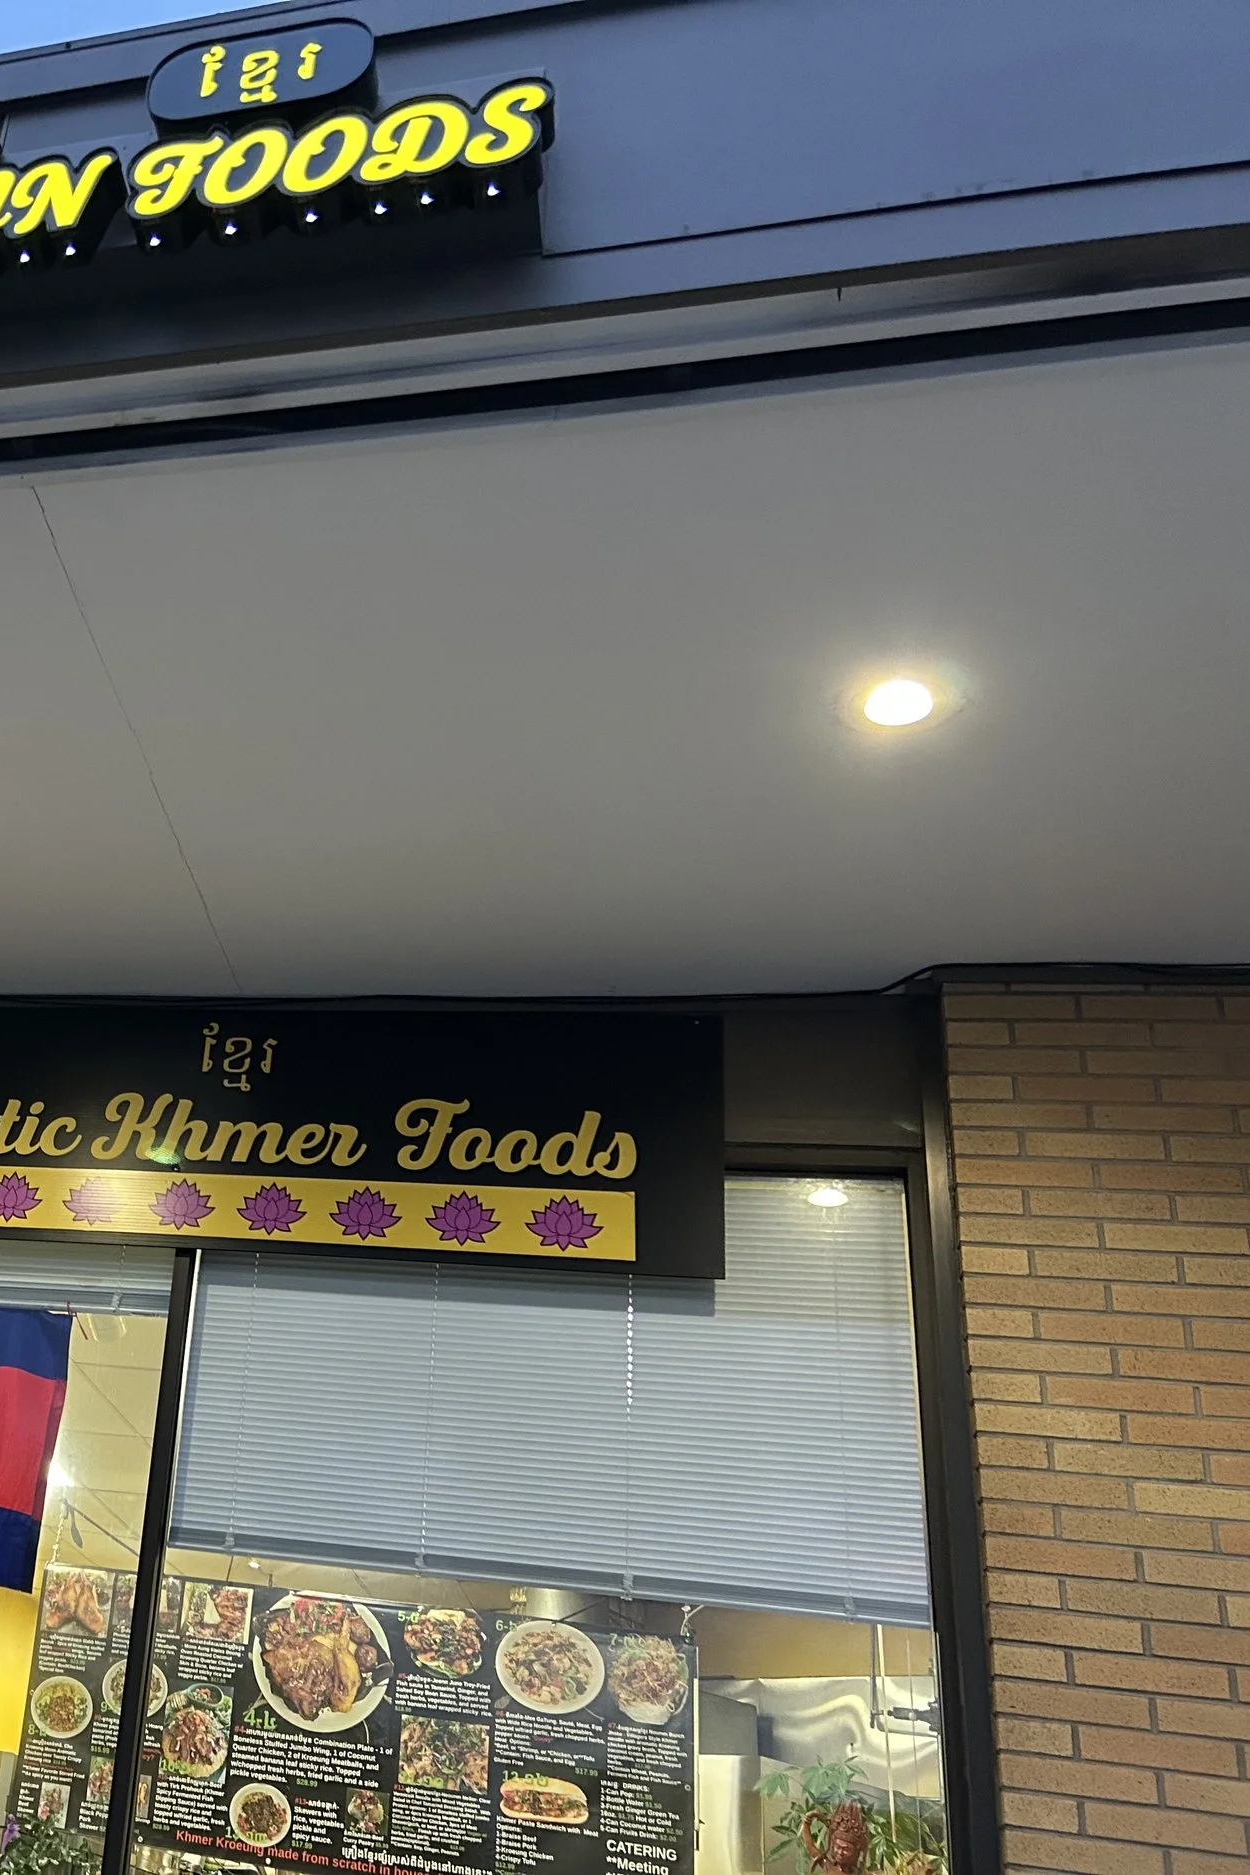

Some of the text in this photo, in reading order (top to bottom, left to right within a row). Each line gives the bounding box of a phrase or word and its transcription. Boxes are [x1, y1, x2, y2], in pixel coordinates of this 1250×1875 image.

[127, 84, 548, 218] FOODS
[91, 1092, 368, 1167] Khmer
[394, 1098, 638, 1180] Foods
[233, 1735, 263, 1746] Boneless
[265, 1739, 287, 1749] Stuffed
[289, 1743, 311, 1753] Jumbo
[347, 1752, 376, 1762] Coconut
[314, 1738, 356, 1750] Combination
[357, 1743, 374, 1752] Plate
[233, 1743, 257, 1753] Quarter
[258, 1747, 286, 1758] Chicken,
[301, 1753, 330, 1765] Kroeung
[331, 1758, 364, 1770] Meatballs,
[366, 1763, 379, 1771] and
[232, 1753, 259, 1762] steamed
[260, 1755, 284, 1766] banana
[286, 1759, 297, 1767] leaf
[300, 1761, 318, 1771] sticky
[336, 1766, 361, 1777] Topped
[575, 1768, 598, 1776] $17.99
[230, 1768, 249, 1777] pickle
[251, 1771, 287, 1783] vegetables.
[267, 1764, 284, 1773] fresh
[286, 1768, 306, 1778] herbs,
[308, 1771, 322, 1780] fried
[324, 1774, 343, 1784] garlic
[344, 1777, 357, 1785] and
[364, 1780, 378, 1788] side
[601, 1788, 619, 1796] 1-Can
[626, 1799, 644, 1807] Water
[294, 1806, 337, 1819] Skewers with
[601, 1802, 679, 1820] 3-Fresh Ginger Green Tea
[293, 1814, 344, 1829] rice, vegetables
[600, 1818, 618, 1826] 4-Can
[620, 1820, 646, 1830] Coconut
[647, 1825, 665, 1833] water
[636, 1815, 647, 1823] Hot
[656, 1818, 671, 1826] Cold
[293, 1824, 312, 1833] pickle
[496, 1823, 522, 1833] Options:
[536, 1822, 566, 1832] Sandwich
[584, 1829, 599, 1837] Meat
[620, 1828, 638, 1837] Fruits
[292, 1832, 310, 1842] spicy
[496, 1831, 537, 1843] 1-Braise Beef
[496, 1838, 537, 1850] 2-Braise Pork
[176, 1829, 213, 1846] Khmer
[216, 1837, 265, 1857] Kroeung
[267, 1846, 299, 1861] made
[302, 1851, 329, 1866] from
[332, 1856, 376, 1874] scratch
[379, 1863, 391, 1875] in
[529, 1851, 554, 1861] Chicken
[606, 1839, 677, 1861] CATERING
[495, 1854, 521, 1864] 4-Crispy
